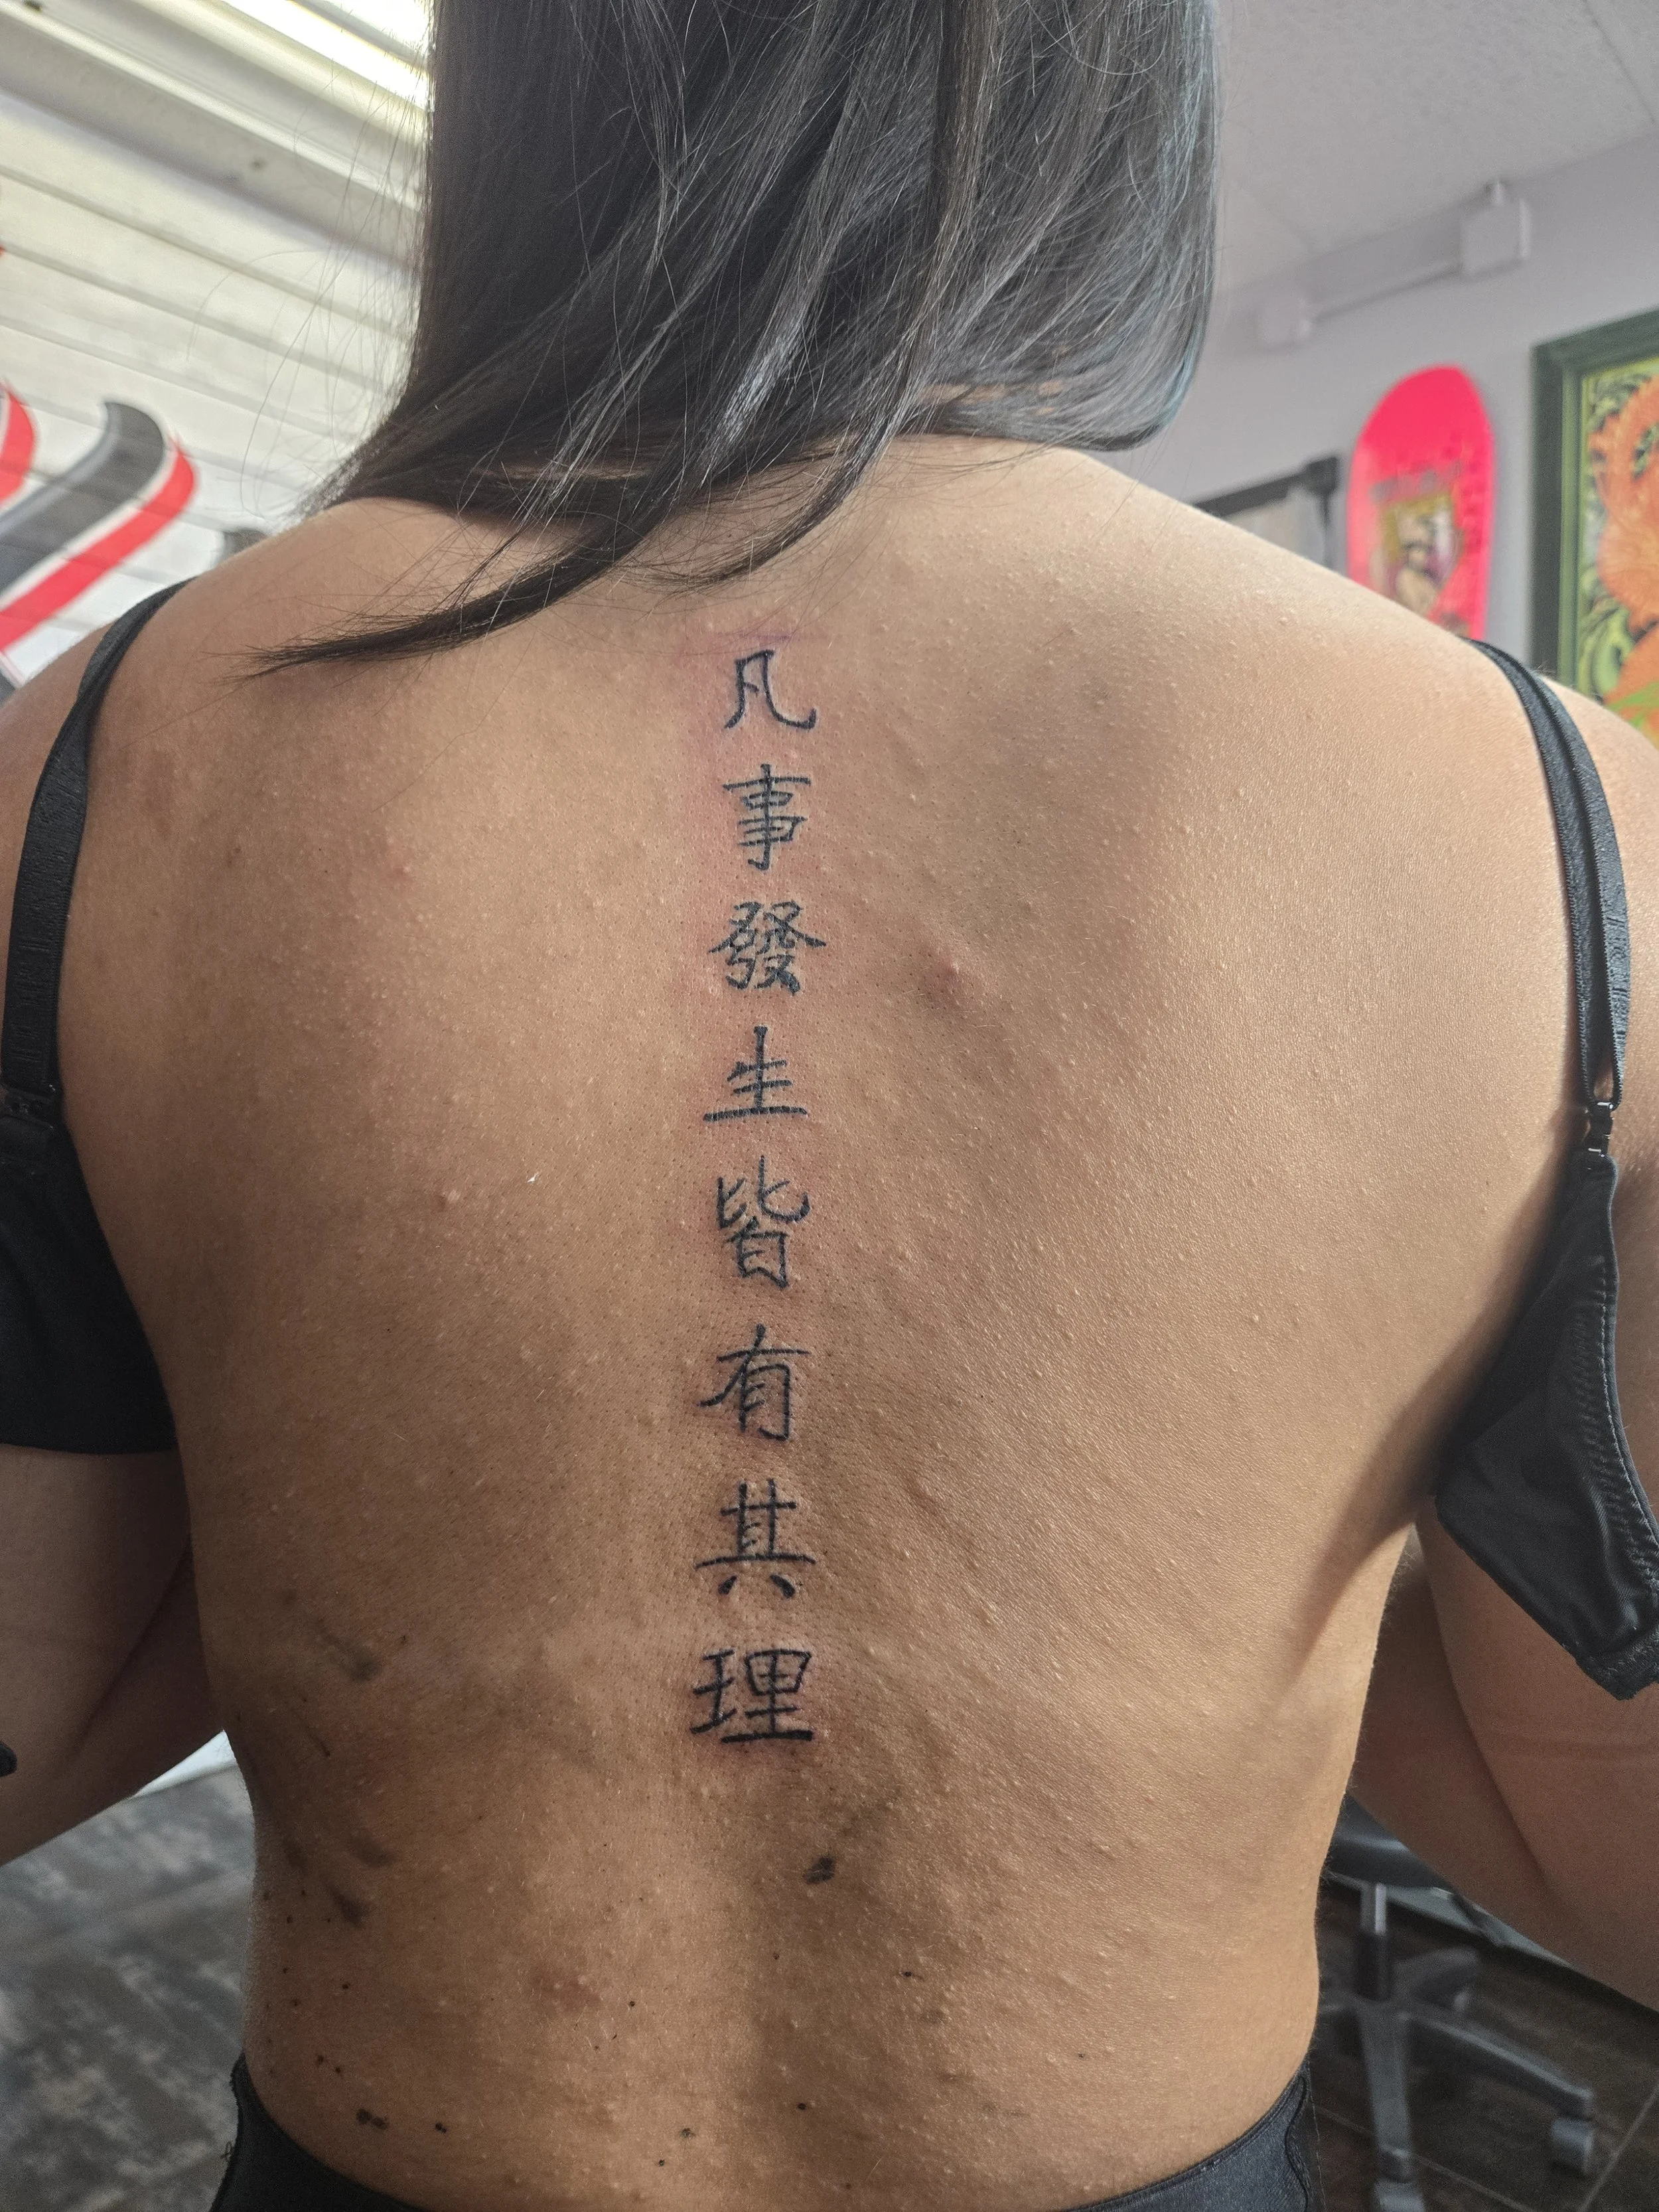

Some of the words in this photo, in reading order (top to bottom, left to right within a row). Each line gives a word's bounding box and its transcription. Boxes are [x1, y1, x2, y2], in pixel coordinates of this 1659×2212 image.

[689, 648, 827, 1745] 凡事發生皆有其理
